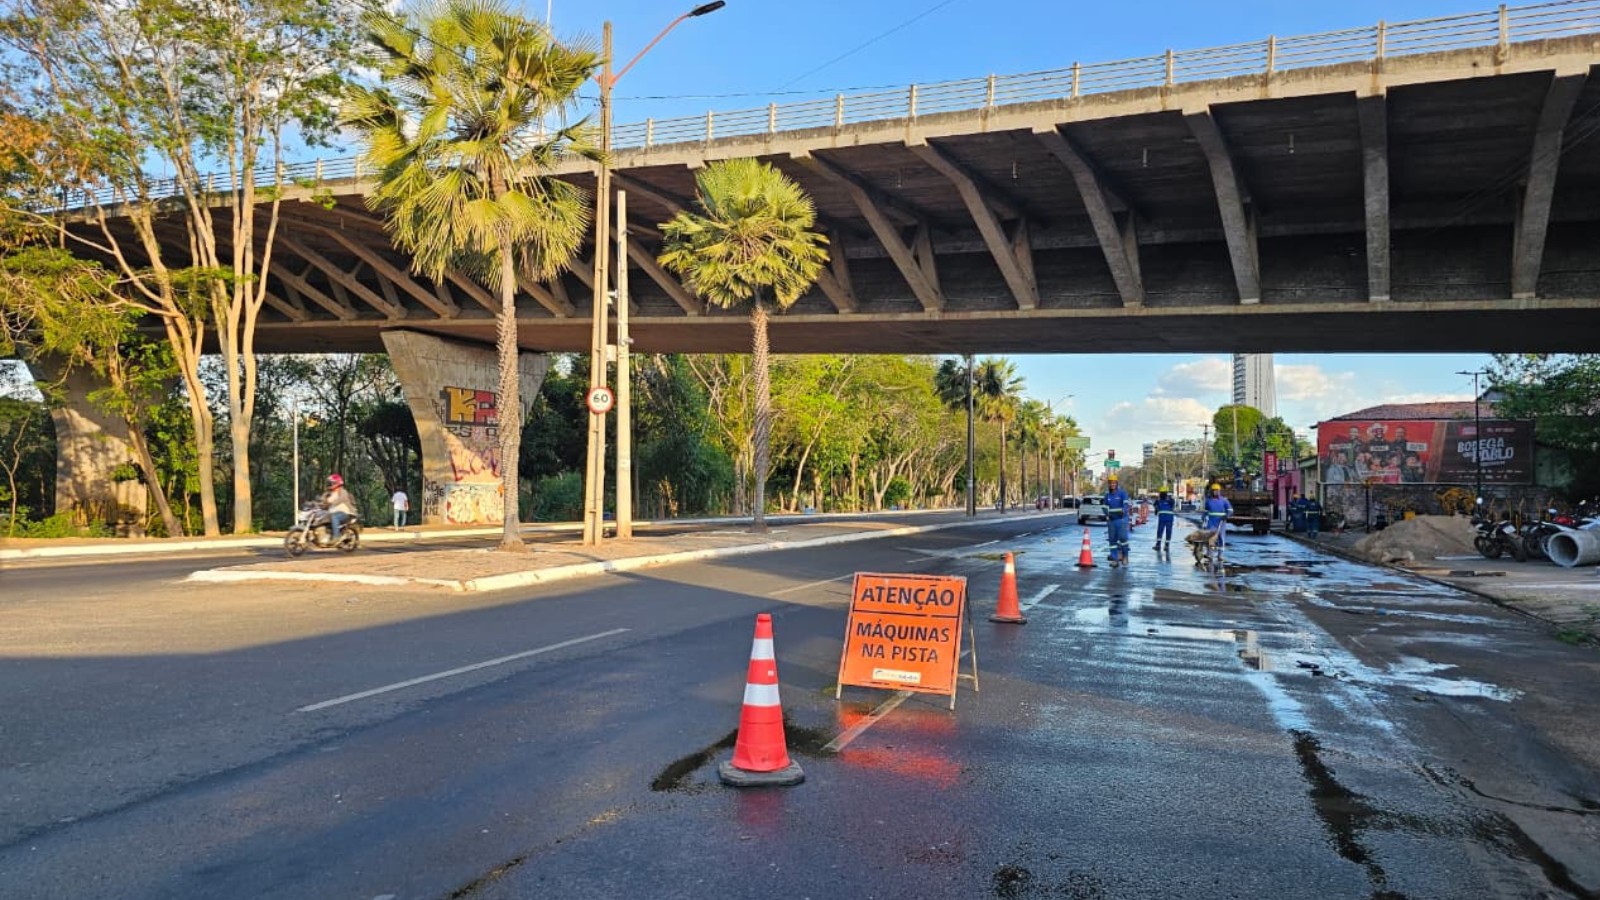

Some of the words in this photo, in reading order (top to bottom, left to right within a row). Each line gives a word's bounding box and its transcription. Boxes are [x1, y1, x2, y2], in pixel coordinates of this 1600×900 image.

[593, 393, 608, 403] 60
[1457, 437, 1505, 452] BODEGA
[861, 584, 955, 610] ATENÇÃO
[855, 619, 950, 643] MÁQUINAS
[861, 643, 885, 659] NA
[891, 646, 939, 664] PISTA
